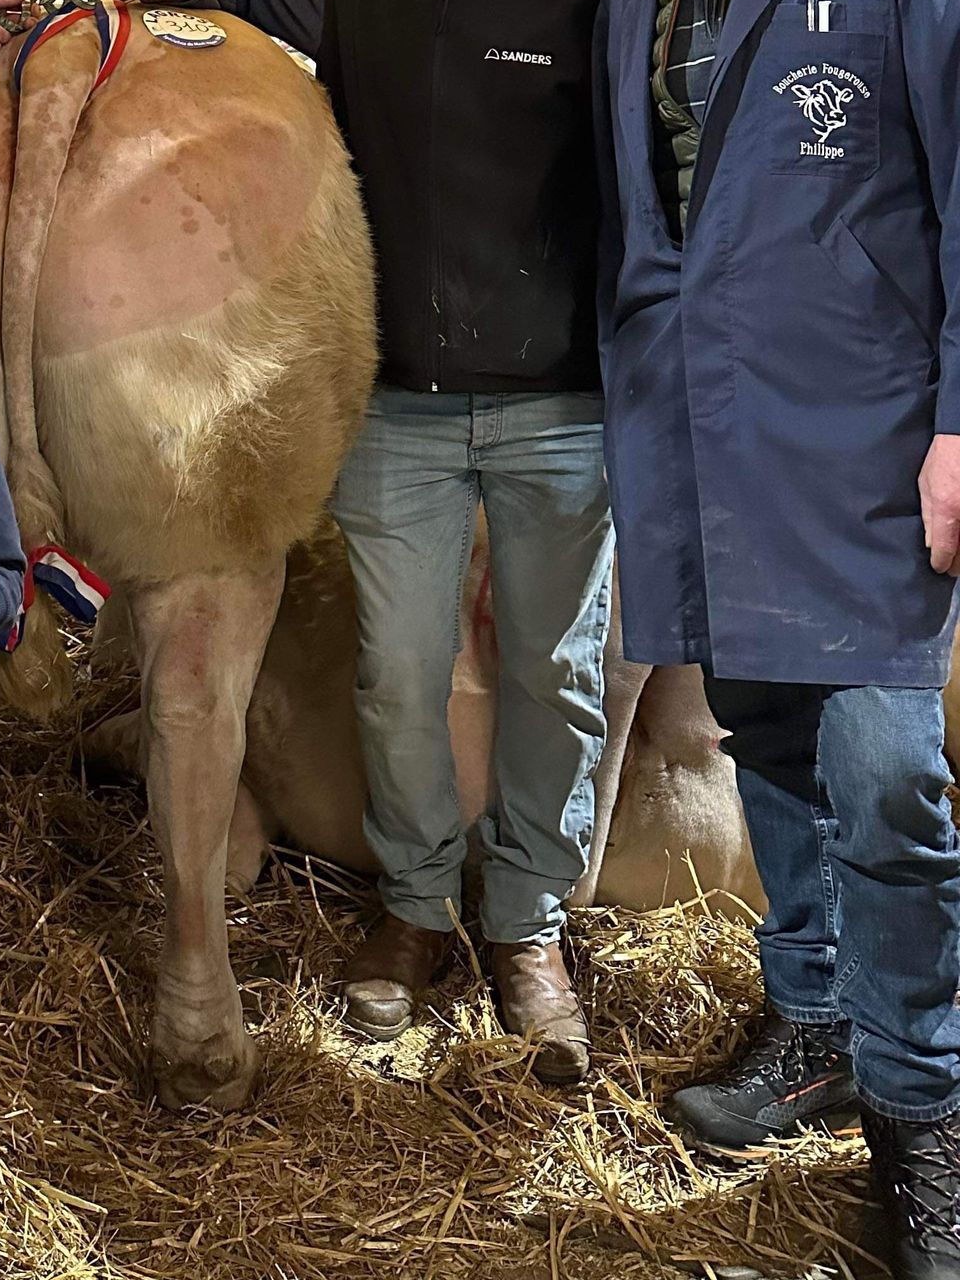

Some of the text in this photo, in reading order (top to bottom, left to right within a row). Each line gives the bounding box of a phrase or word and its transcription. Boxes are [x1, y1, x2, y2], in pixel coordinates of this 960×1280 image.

[500, 50, 552, 65] SANDERS
[772, 64, 818, 95] Boucherie
[800, 141, 845, 159] Philippe
